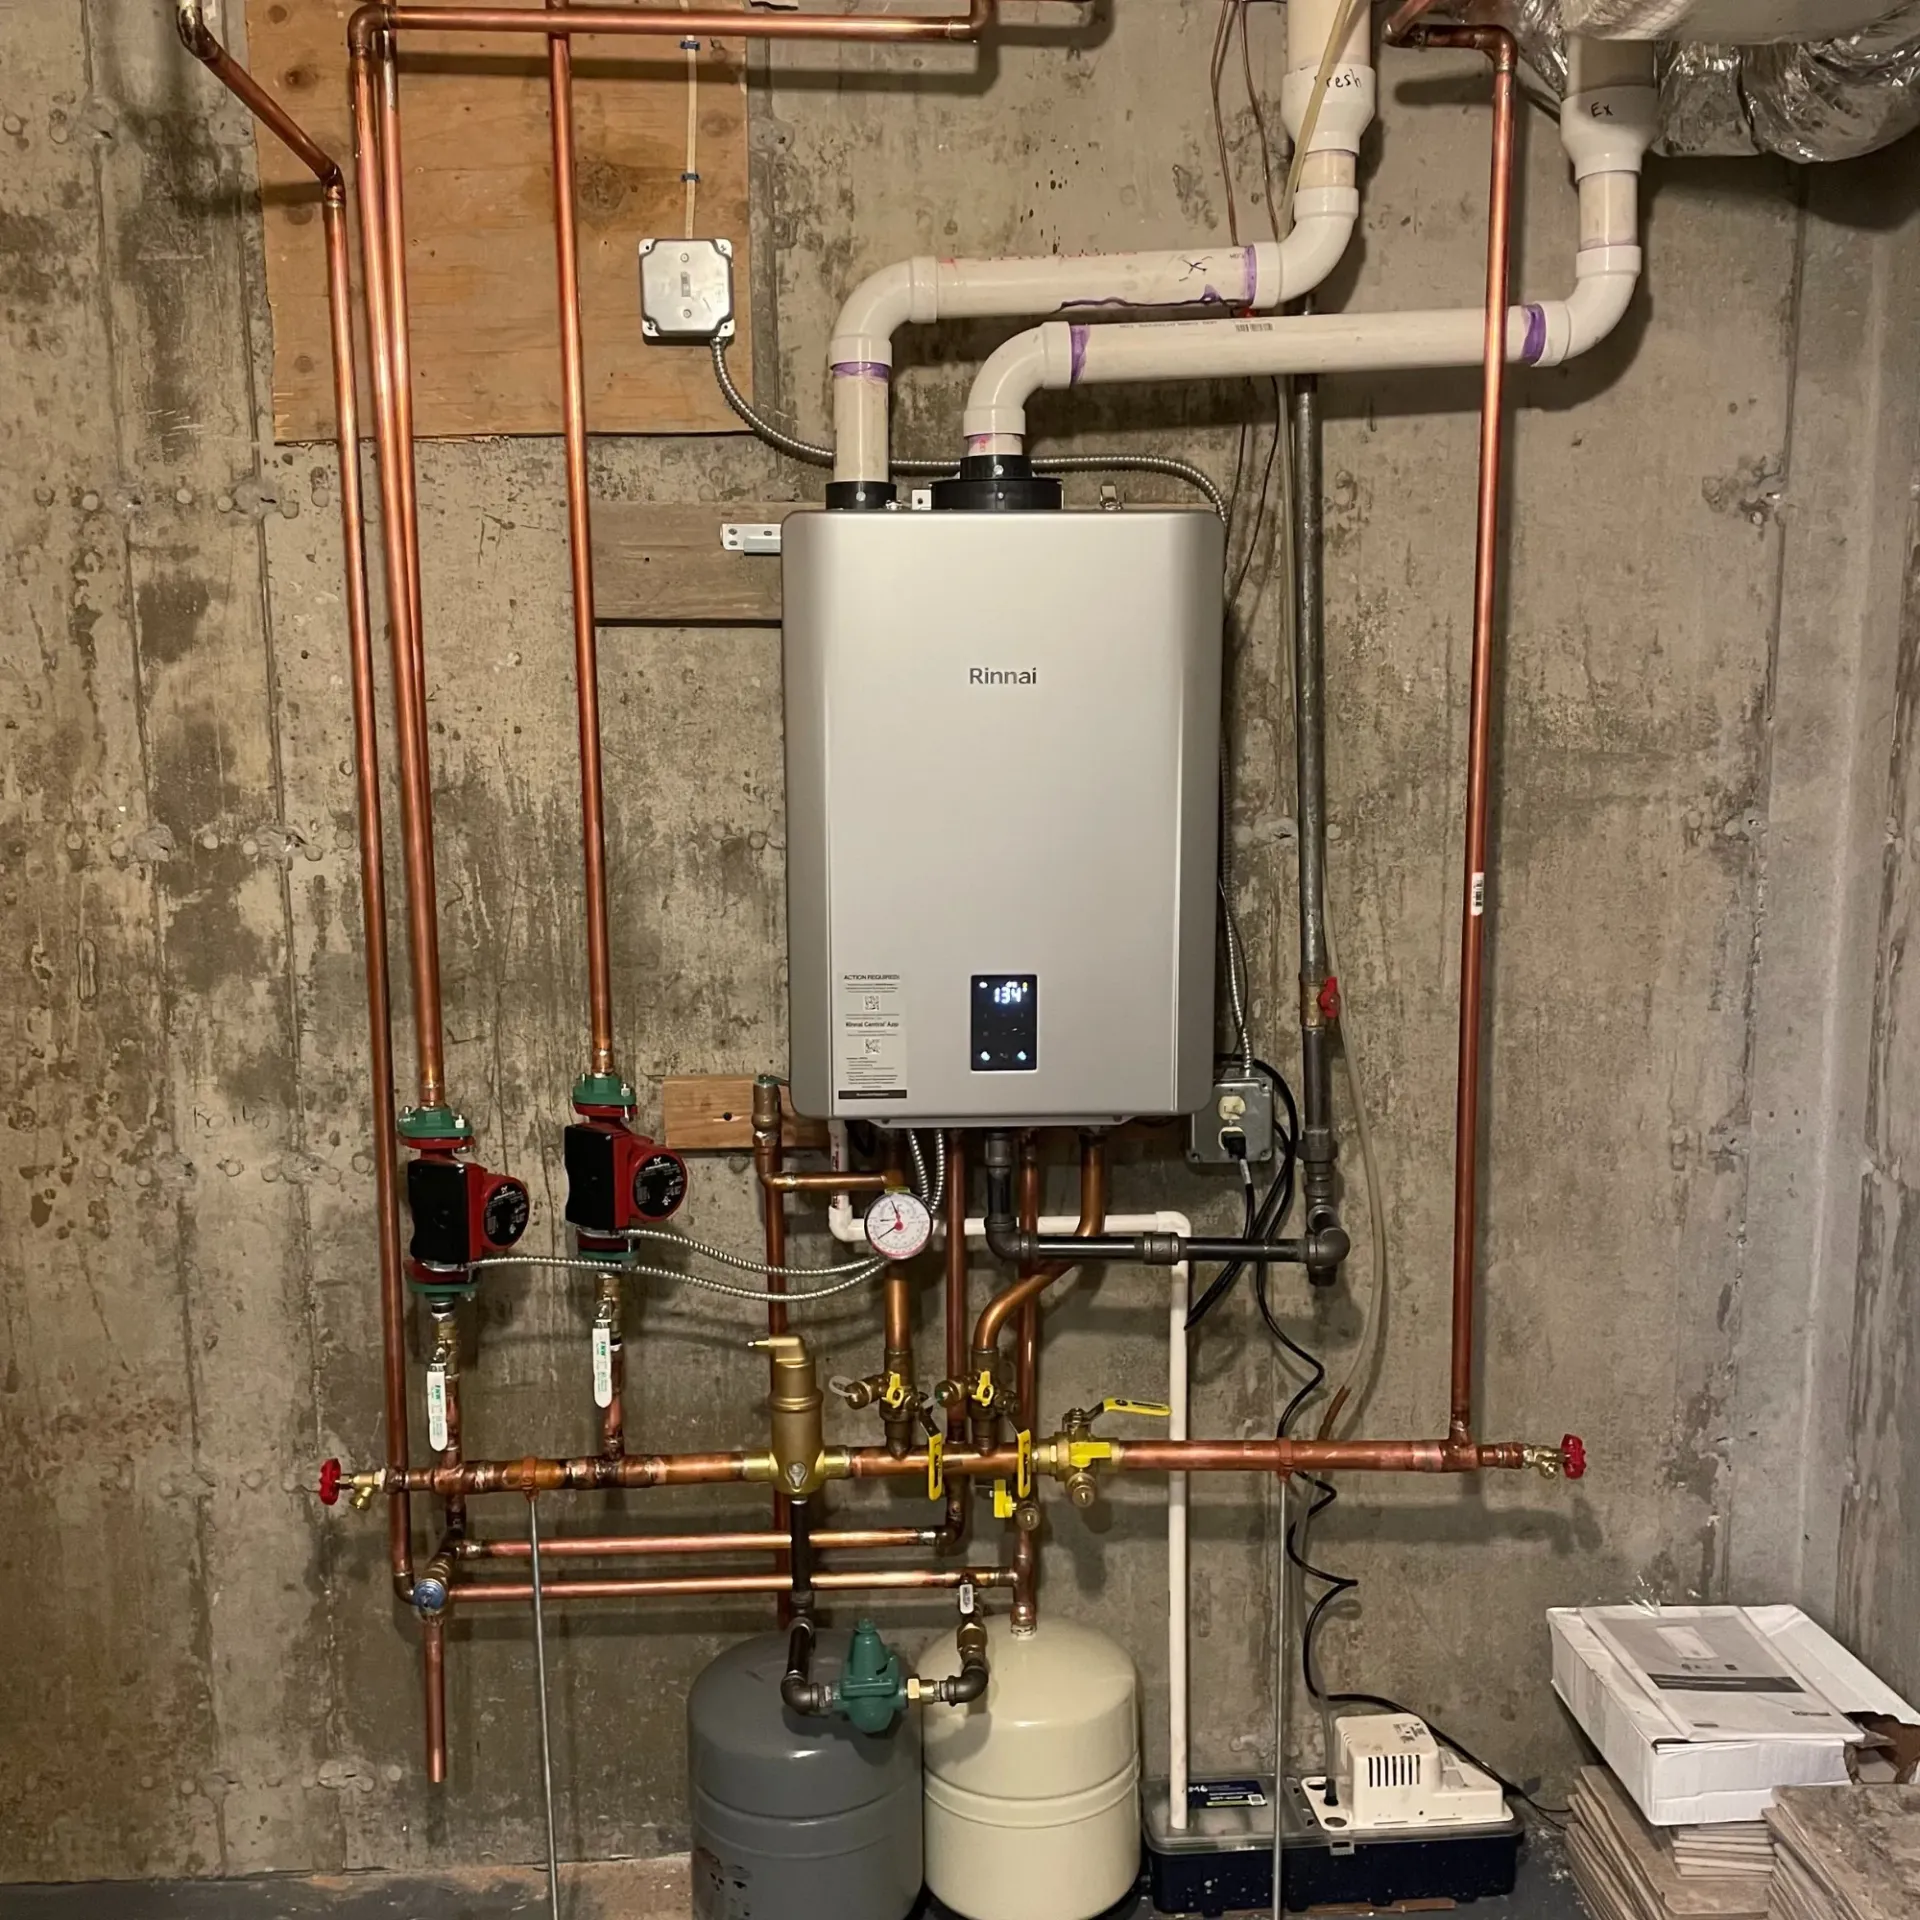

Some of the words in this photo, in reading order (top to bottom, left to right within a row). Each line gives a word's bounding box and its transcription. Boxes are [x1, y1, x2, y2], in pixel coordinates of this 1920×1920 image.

[1314, 68, 1361, 88] resh
[1591, 101, 1613, 118] Ex
[969, 667, 1037, 684] Rinnai
